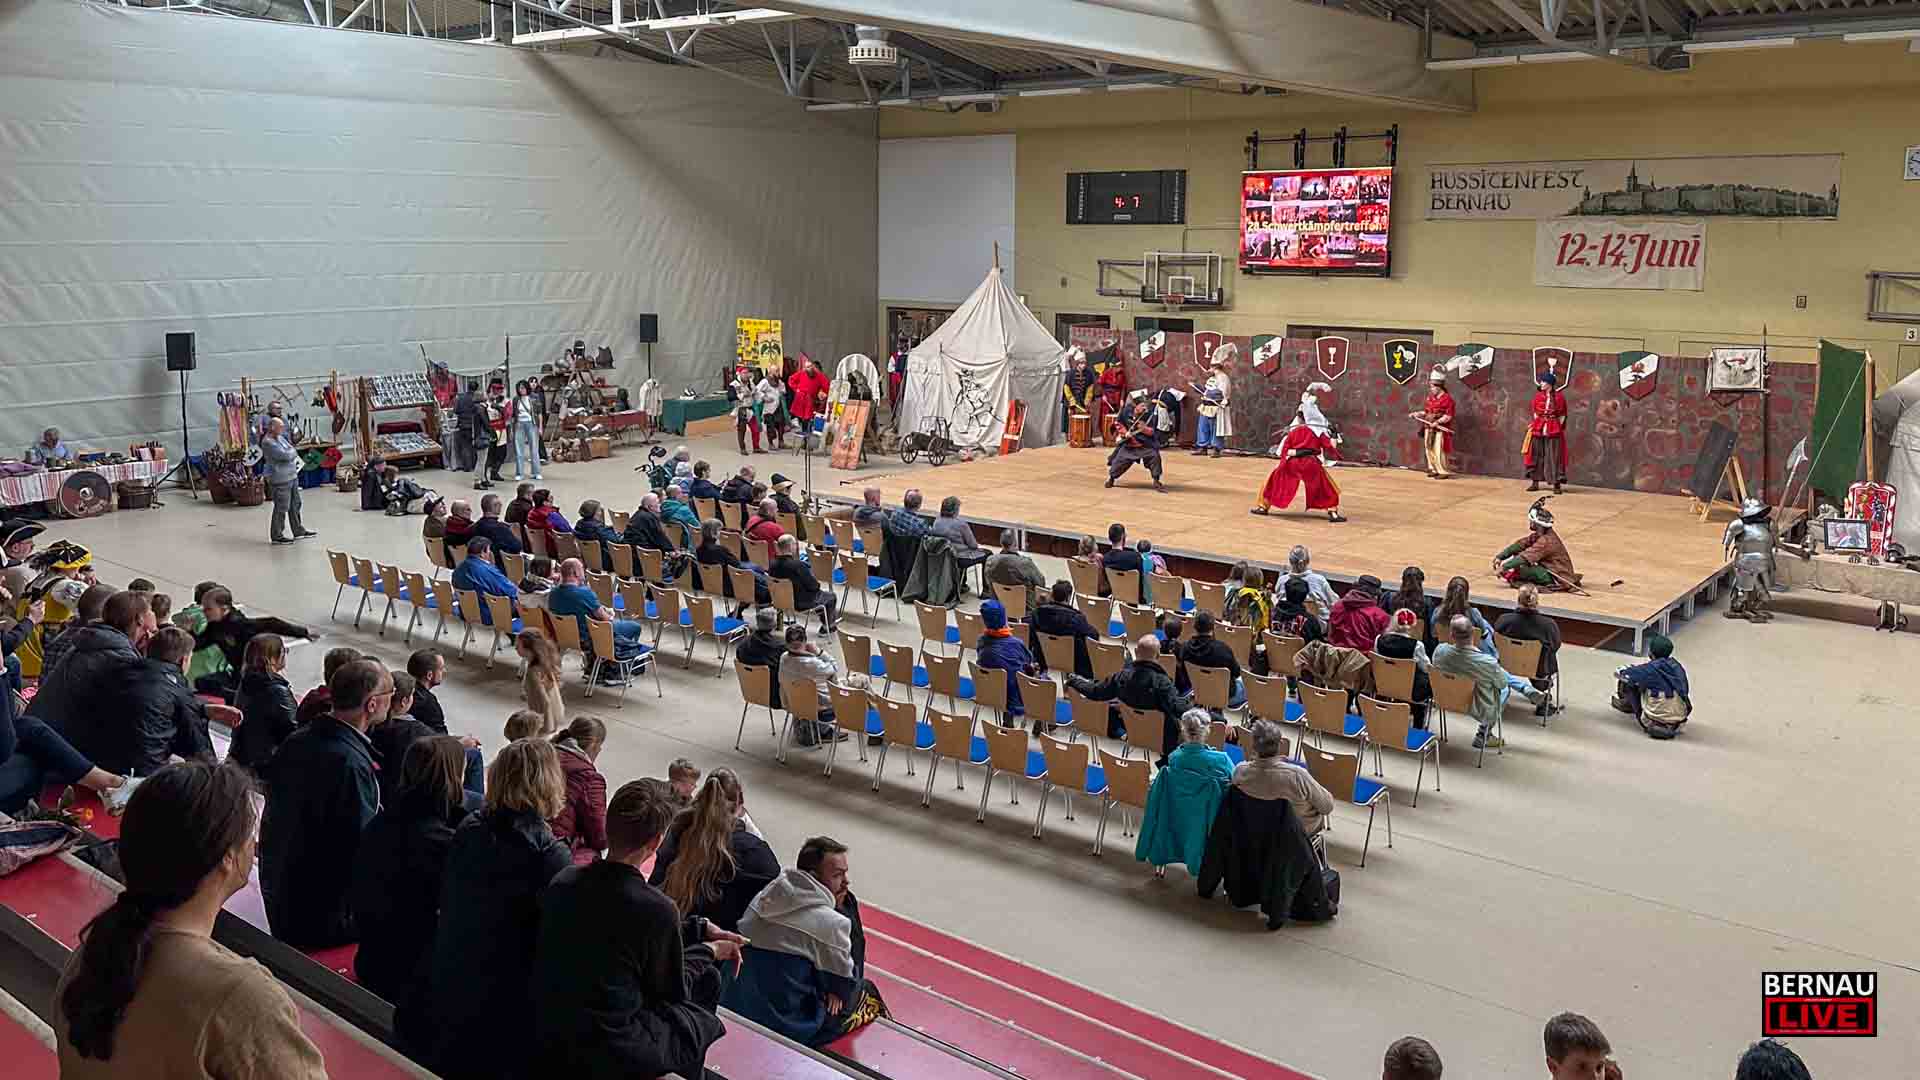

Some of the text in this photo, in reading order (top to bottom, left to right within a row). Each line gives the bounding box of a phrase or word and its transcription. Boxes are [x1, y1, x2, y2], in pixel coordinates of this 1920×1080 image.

[1431, 168, 1585, 190] HUSSITENFEST
[1431, 192, 1512, 213] BERNAU
[1624, 233, 1701, 274] Juni
[1908, 330, 1915, 340] 3
